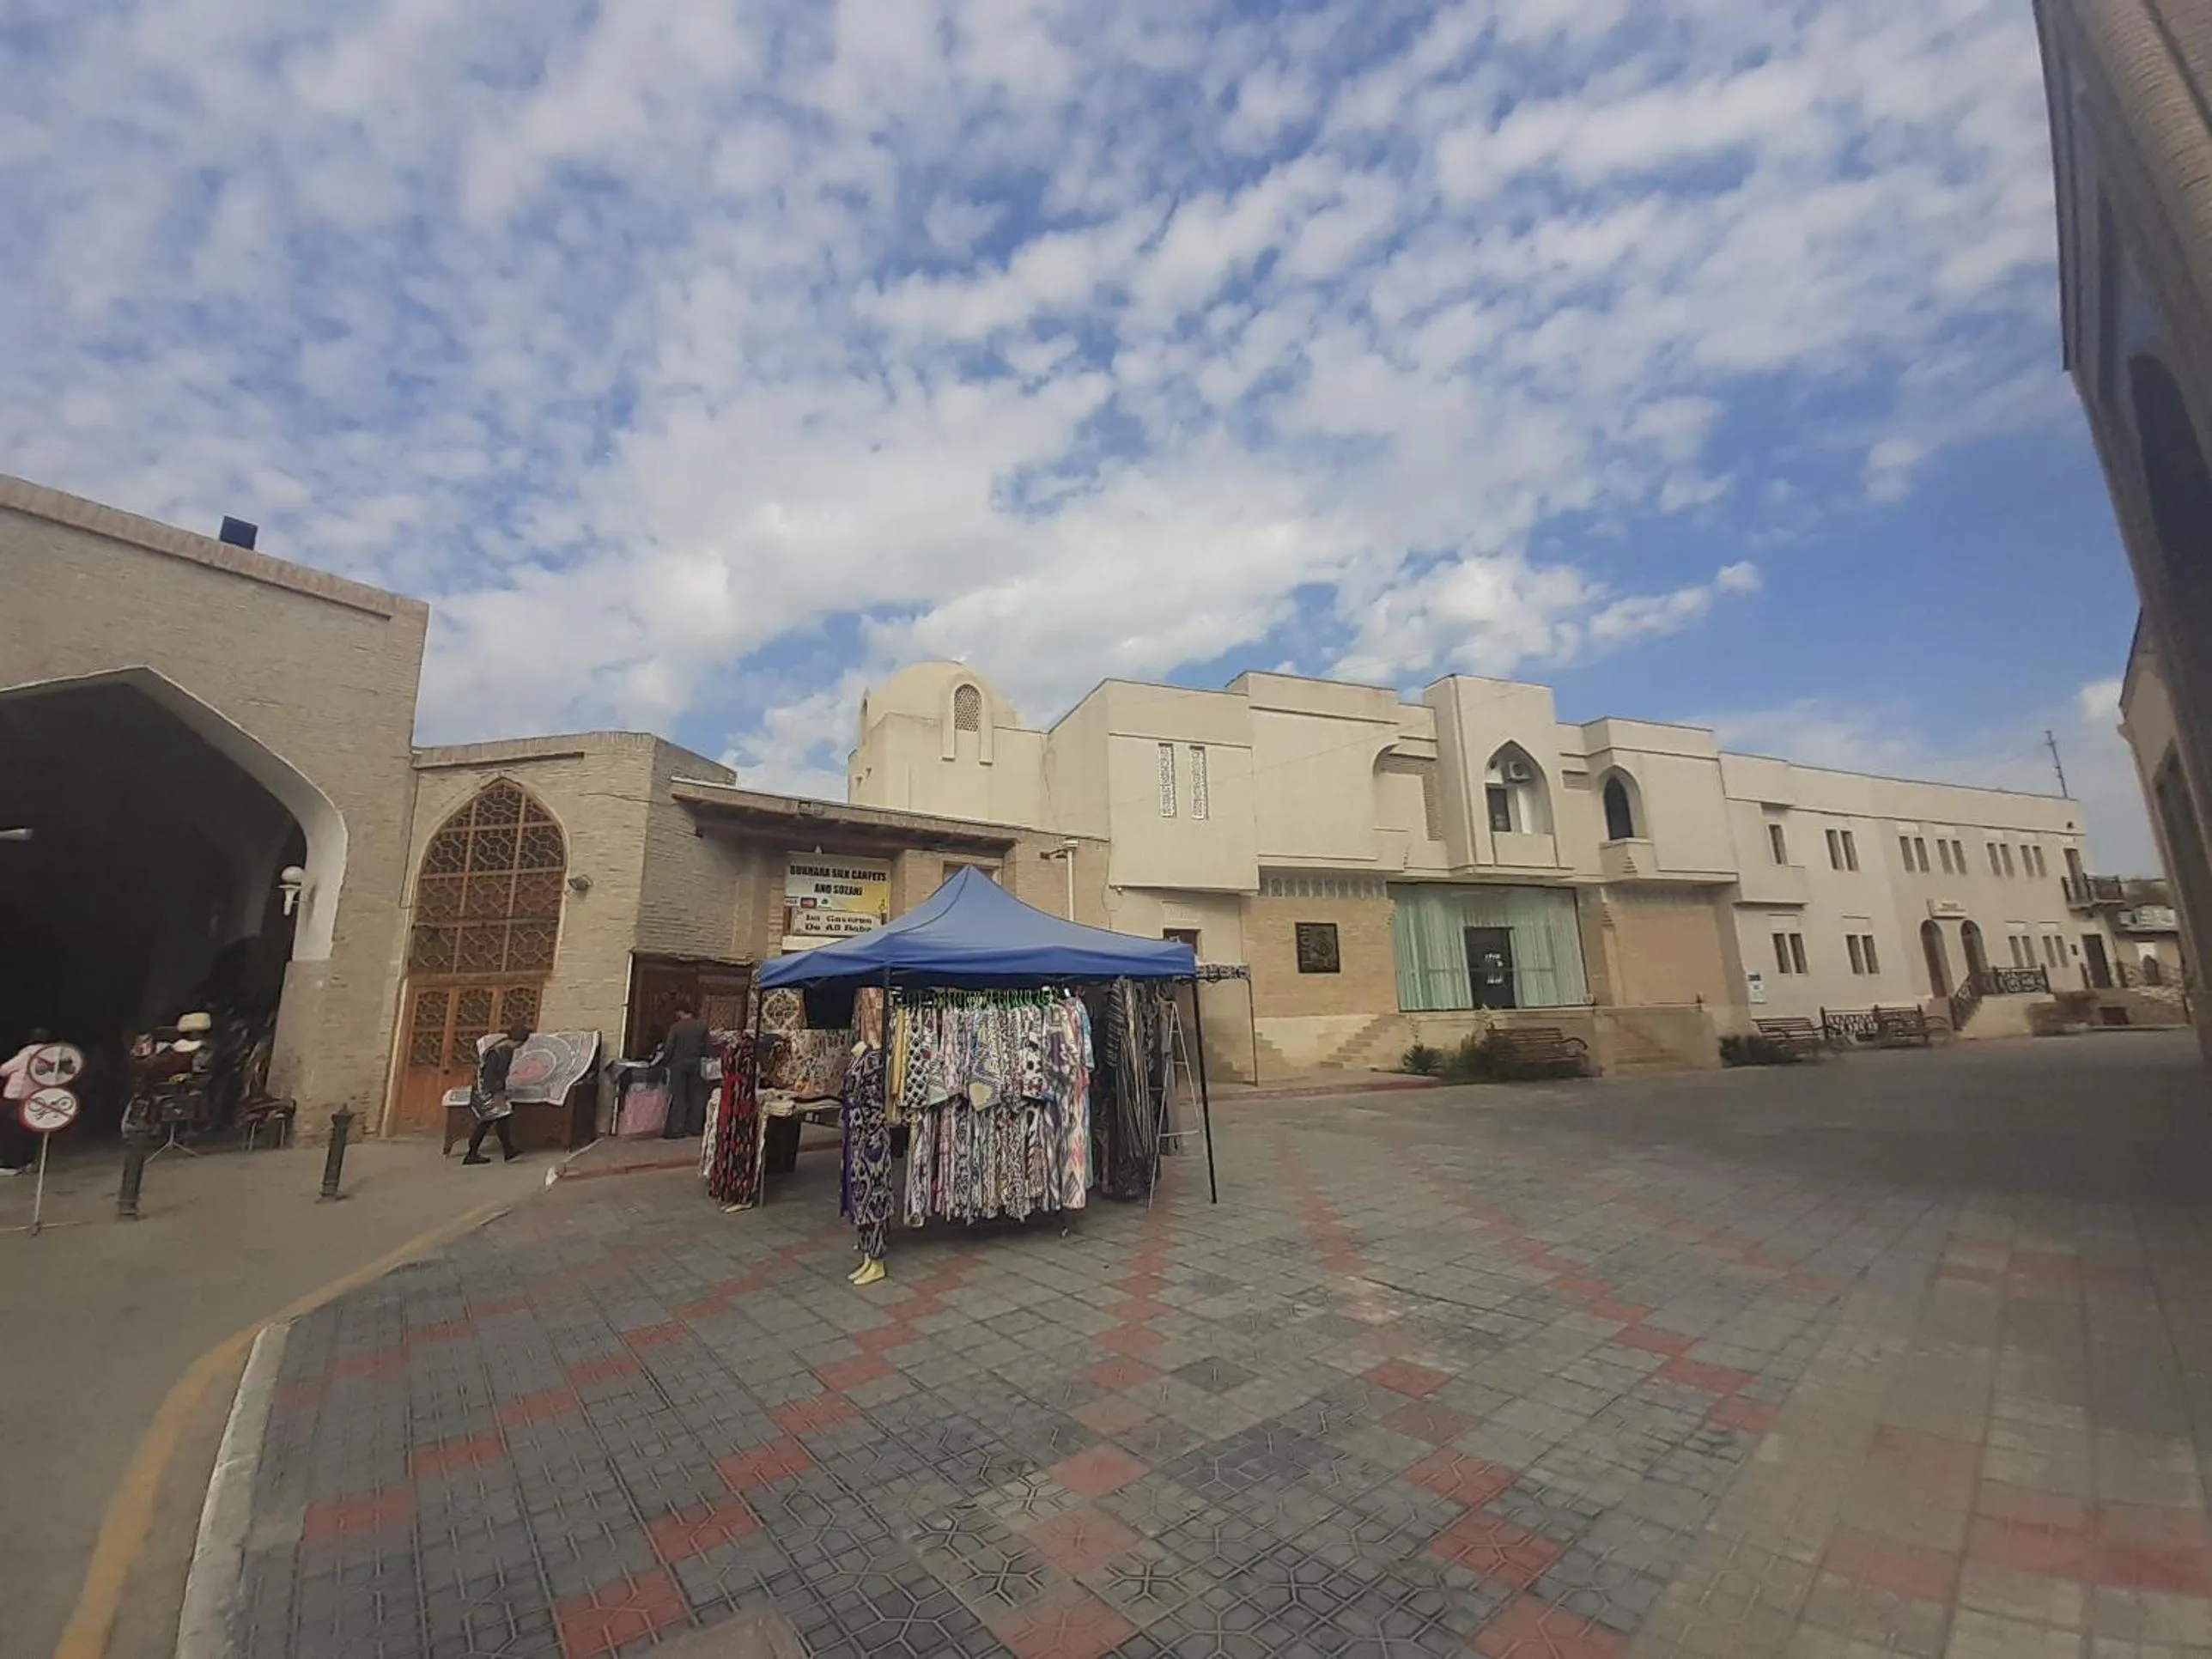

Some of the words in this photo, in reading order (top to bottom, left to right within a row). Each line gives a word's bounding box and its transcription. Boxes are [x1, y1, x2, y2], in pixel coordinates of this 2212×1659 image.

[790, 866, 830, 877] BUKHARA
[831, 868, 850, 878] SILK
[852, 870, 887, 881] CARPETS
[814, 883, 832, 893] AND
[833, 884, 863, 896] SOZANI
